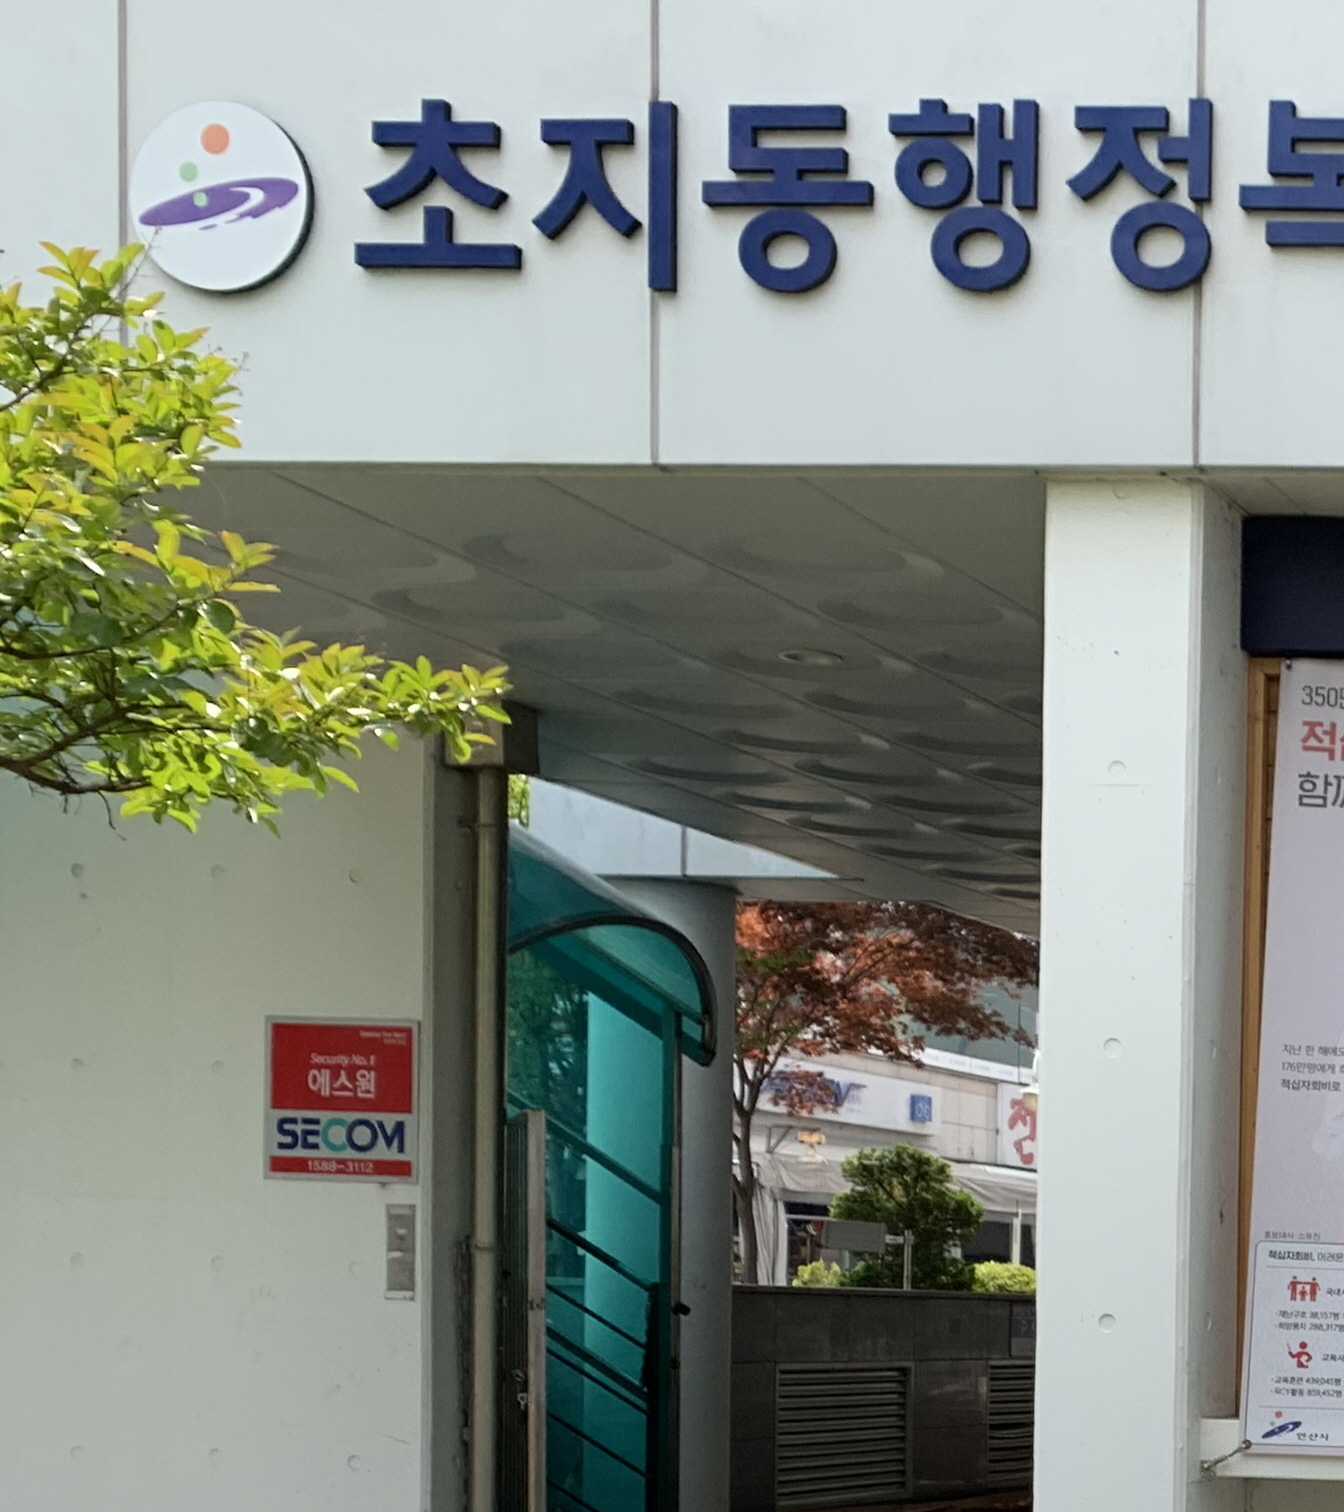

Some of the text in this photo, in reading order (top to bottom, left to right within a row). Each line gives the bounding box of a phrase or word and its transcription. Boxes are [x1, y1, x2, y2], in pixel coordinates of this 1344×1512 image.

[307, 1069, 375, 1099] 에스원
[277, 1117, 405, 1153] SECOM
[307, 1159, 373, 1173] 1588-3112
